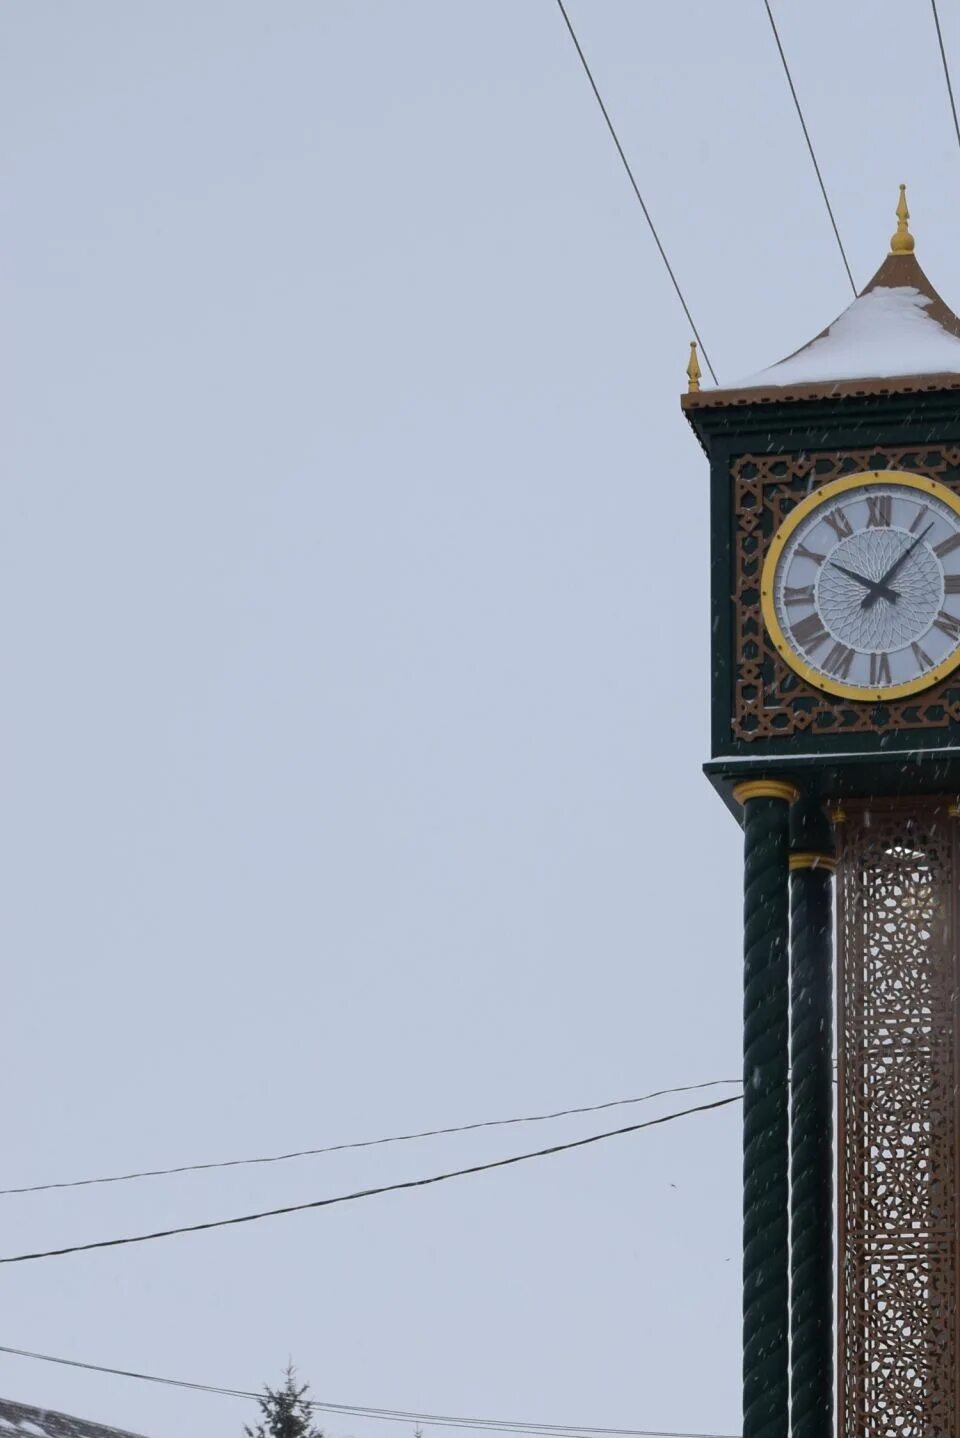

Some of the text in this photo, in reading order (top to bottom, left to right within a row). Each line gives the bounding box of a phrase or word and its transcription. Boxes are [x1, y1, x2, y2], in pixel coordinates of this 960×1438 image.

[822, 507, 853, 542] XI
[866, 495, 892, 529] XII
[793, 543, 827, 567] X
[870, 652, 892, 685] VI
[911, 641, 935, 672] V
